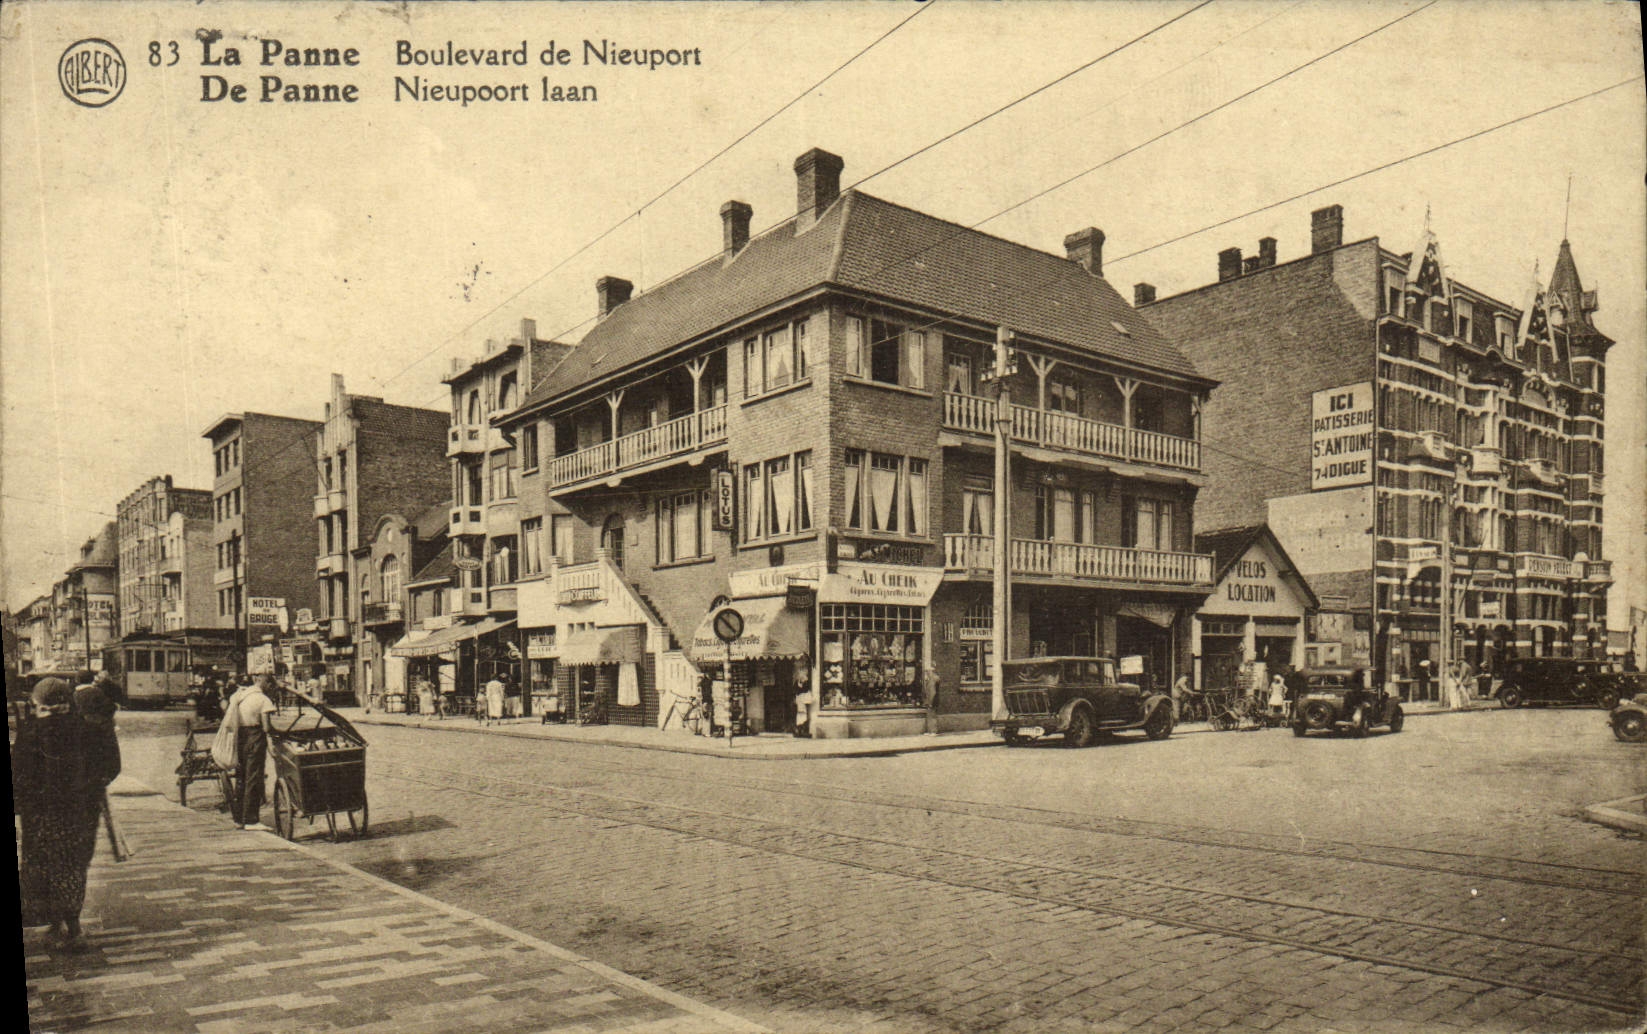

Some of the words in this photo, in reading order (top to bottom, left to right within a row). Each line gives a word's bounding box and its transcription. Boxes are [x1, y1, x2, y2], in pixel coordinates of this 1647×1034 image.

[1329, 392, 1354, 412] ICI
[1314, 409, 1374, 433] PATISSERIE
[721, 478, 731, 525] LOTUS
[1236, 560, 1267, 579] VELOS
[1227, 582, 1277, 603] LOCATION
